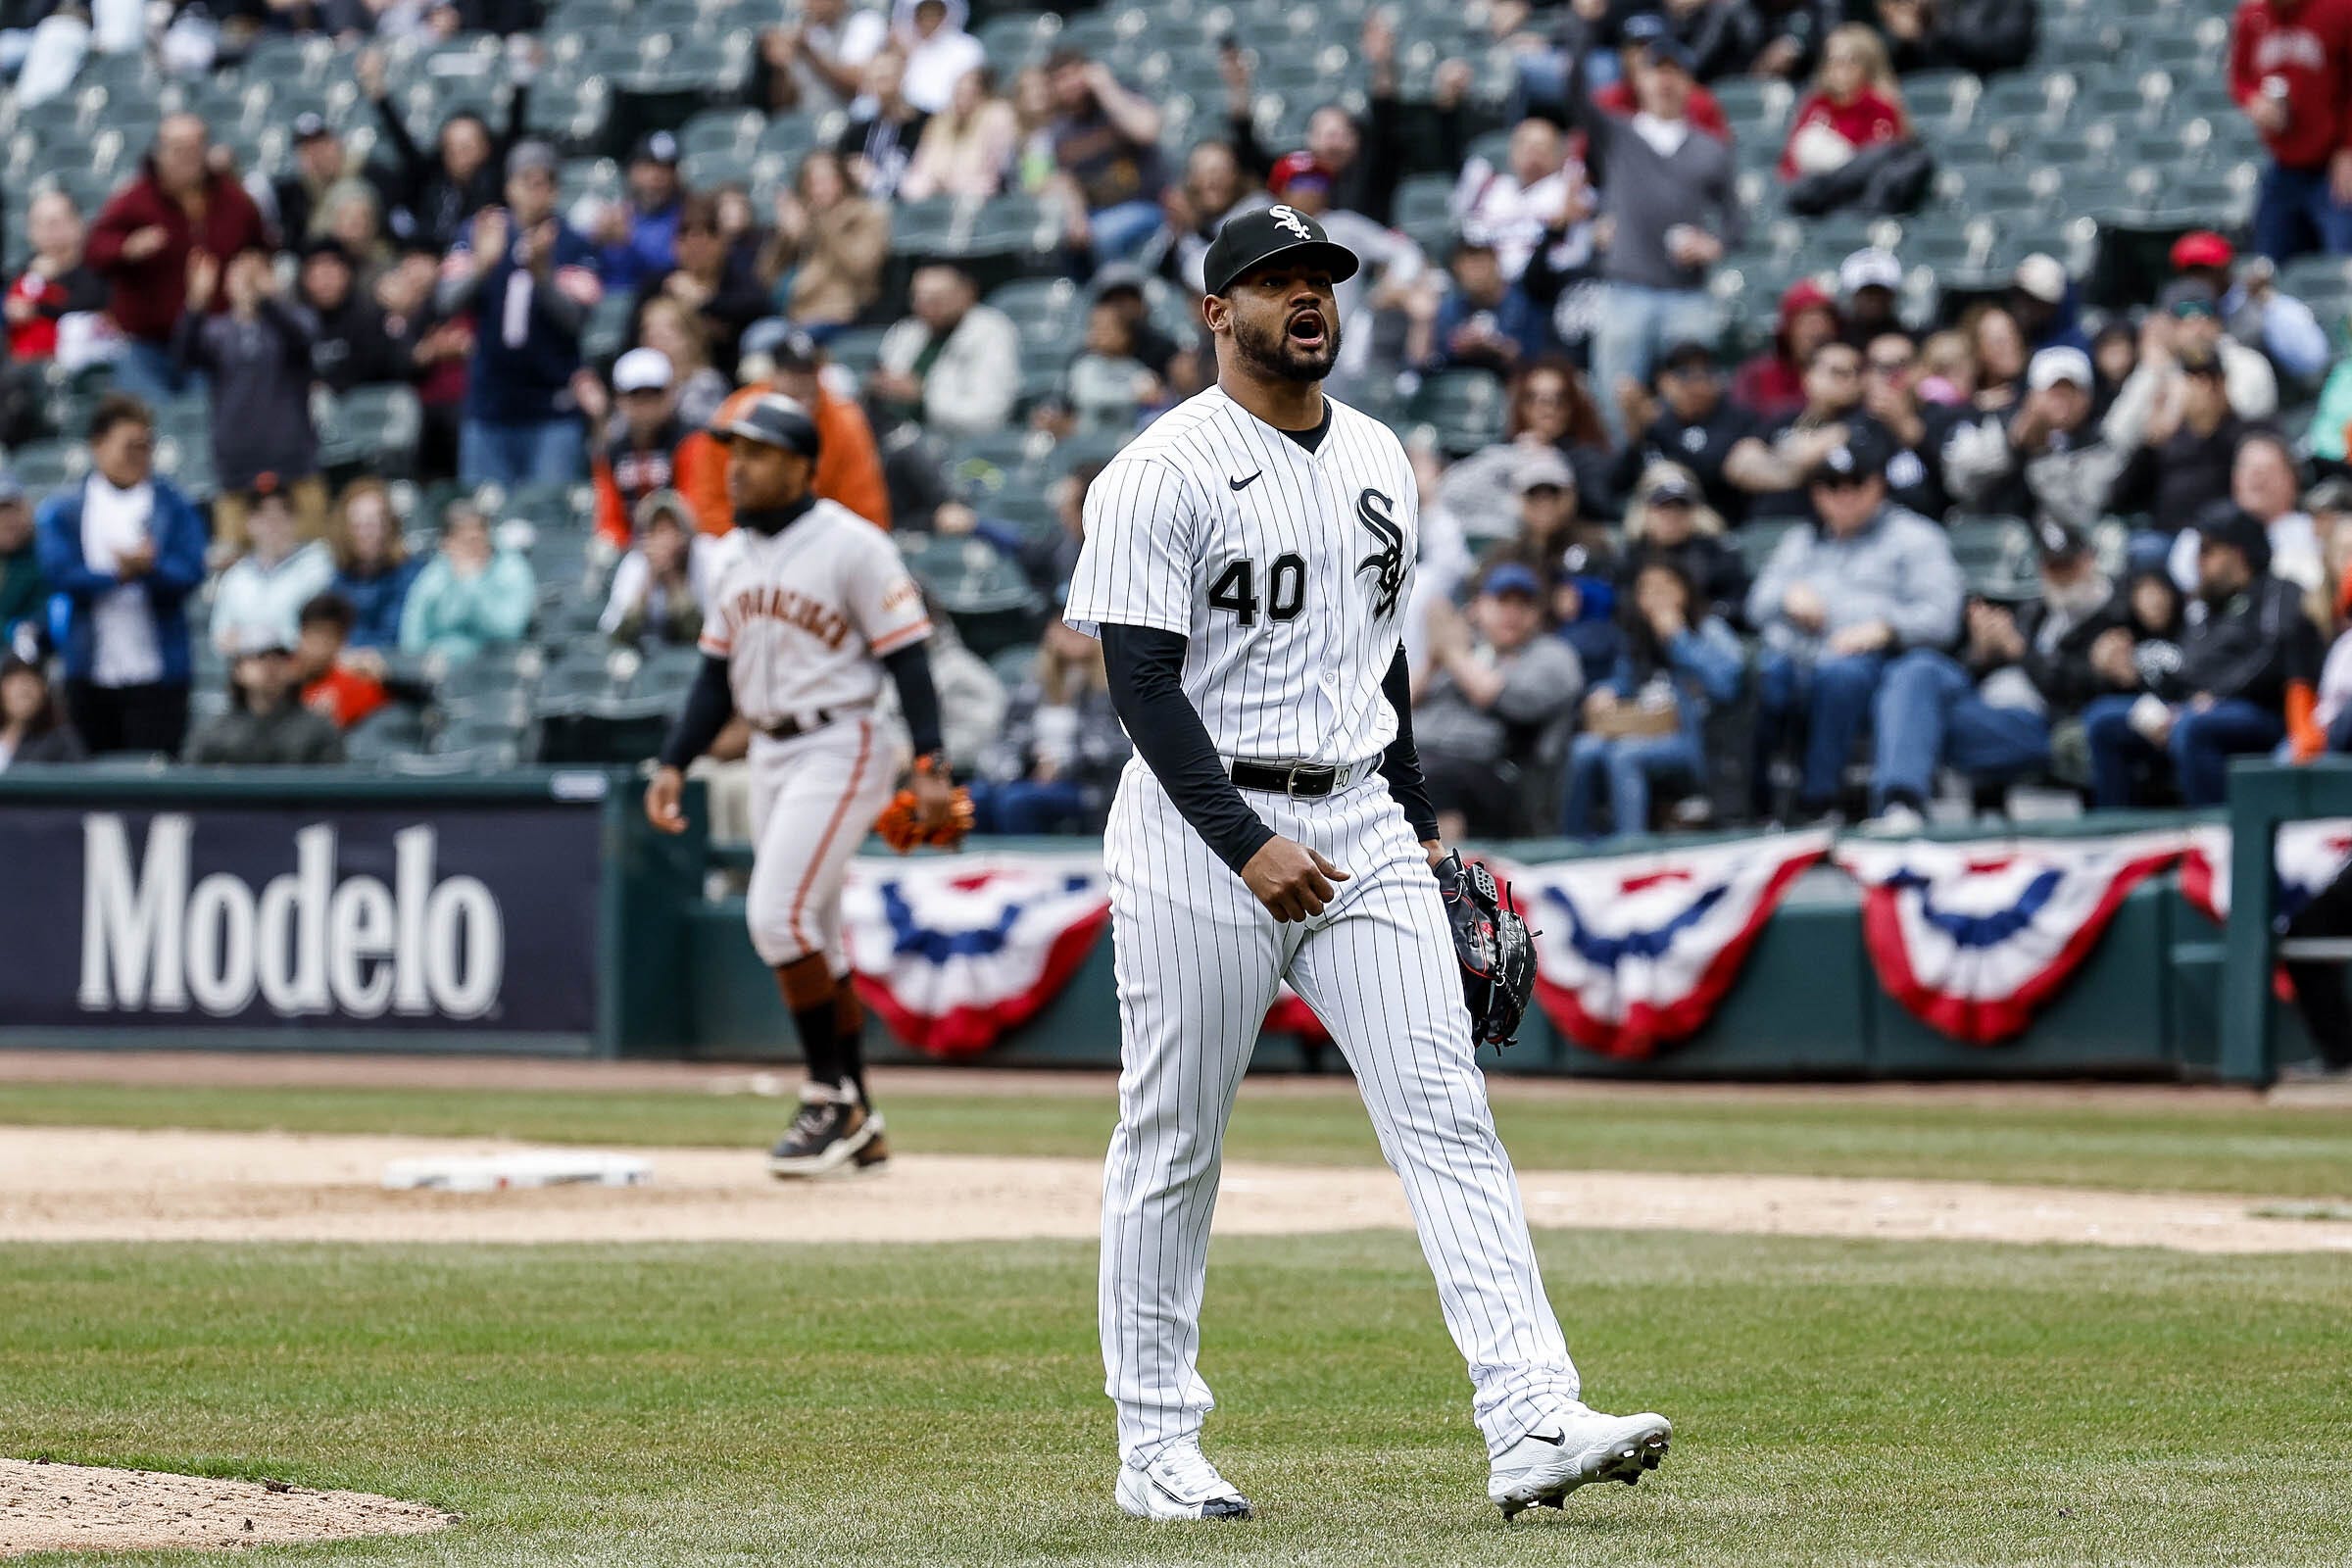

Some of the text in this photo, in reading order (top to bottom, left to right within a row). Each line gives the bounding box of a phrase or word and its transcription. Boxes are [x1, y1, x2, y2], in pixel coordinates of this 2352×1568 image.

[1205, 551, 1307, 627] 40
[1336, 768, 1349, 788] 40
[77, 811, 505, 1019] Modelo
